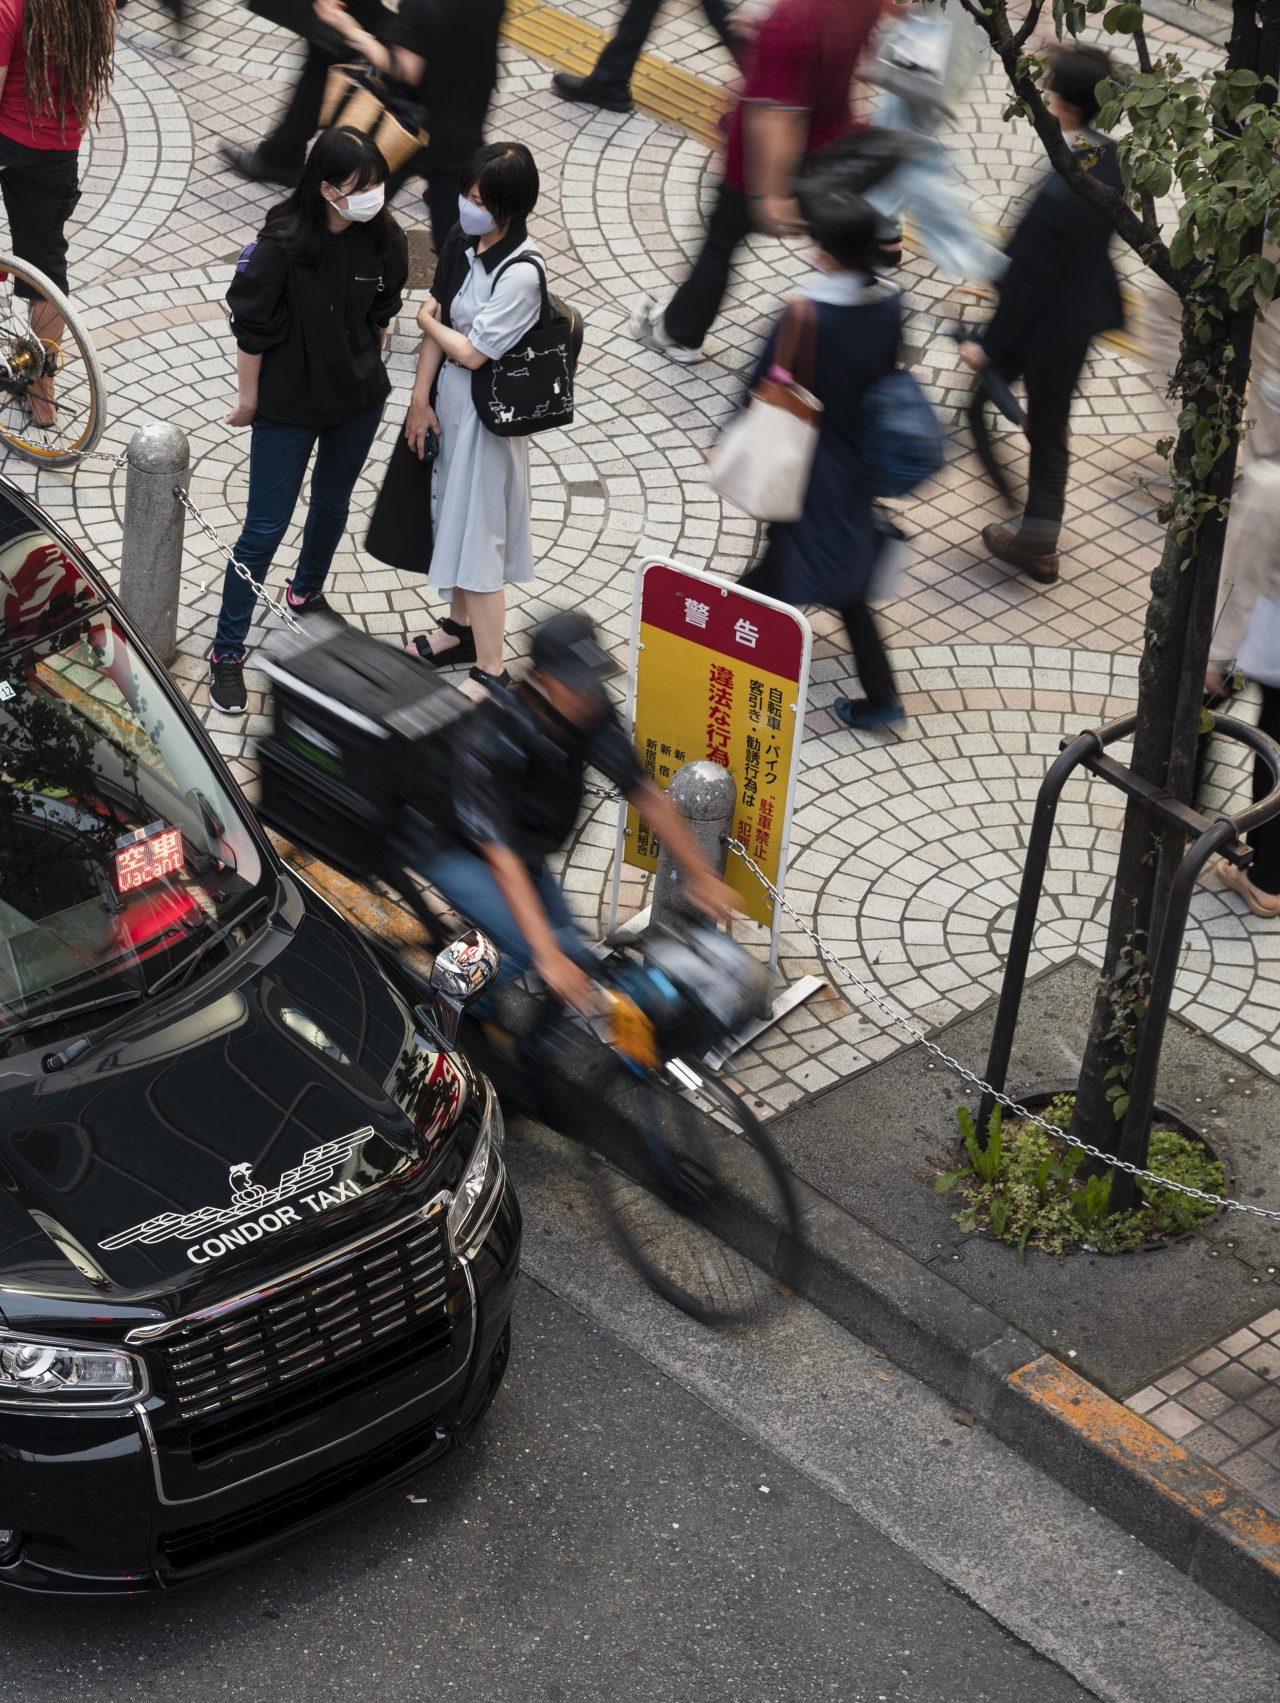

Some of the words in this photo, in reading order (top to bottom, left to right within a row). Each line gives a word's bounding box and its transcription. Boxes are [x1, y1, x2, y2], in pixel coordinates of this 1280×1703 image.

[684, 597, 759, 648] 警告
[1, 686, 14, 698] 12
[119, 831, 179, 873] 空車
[186, 1204, 303, 1264] CONDOR
[298, 1179, 363, 1213] TAXI
